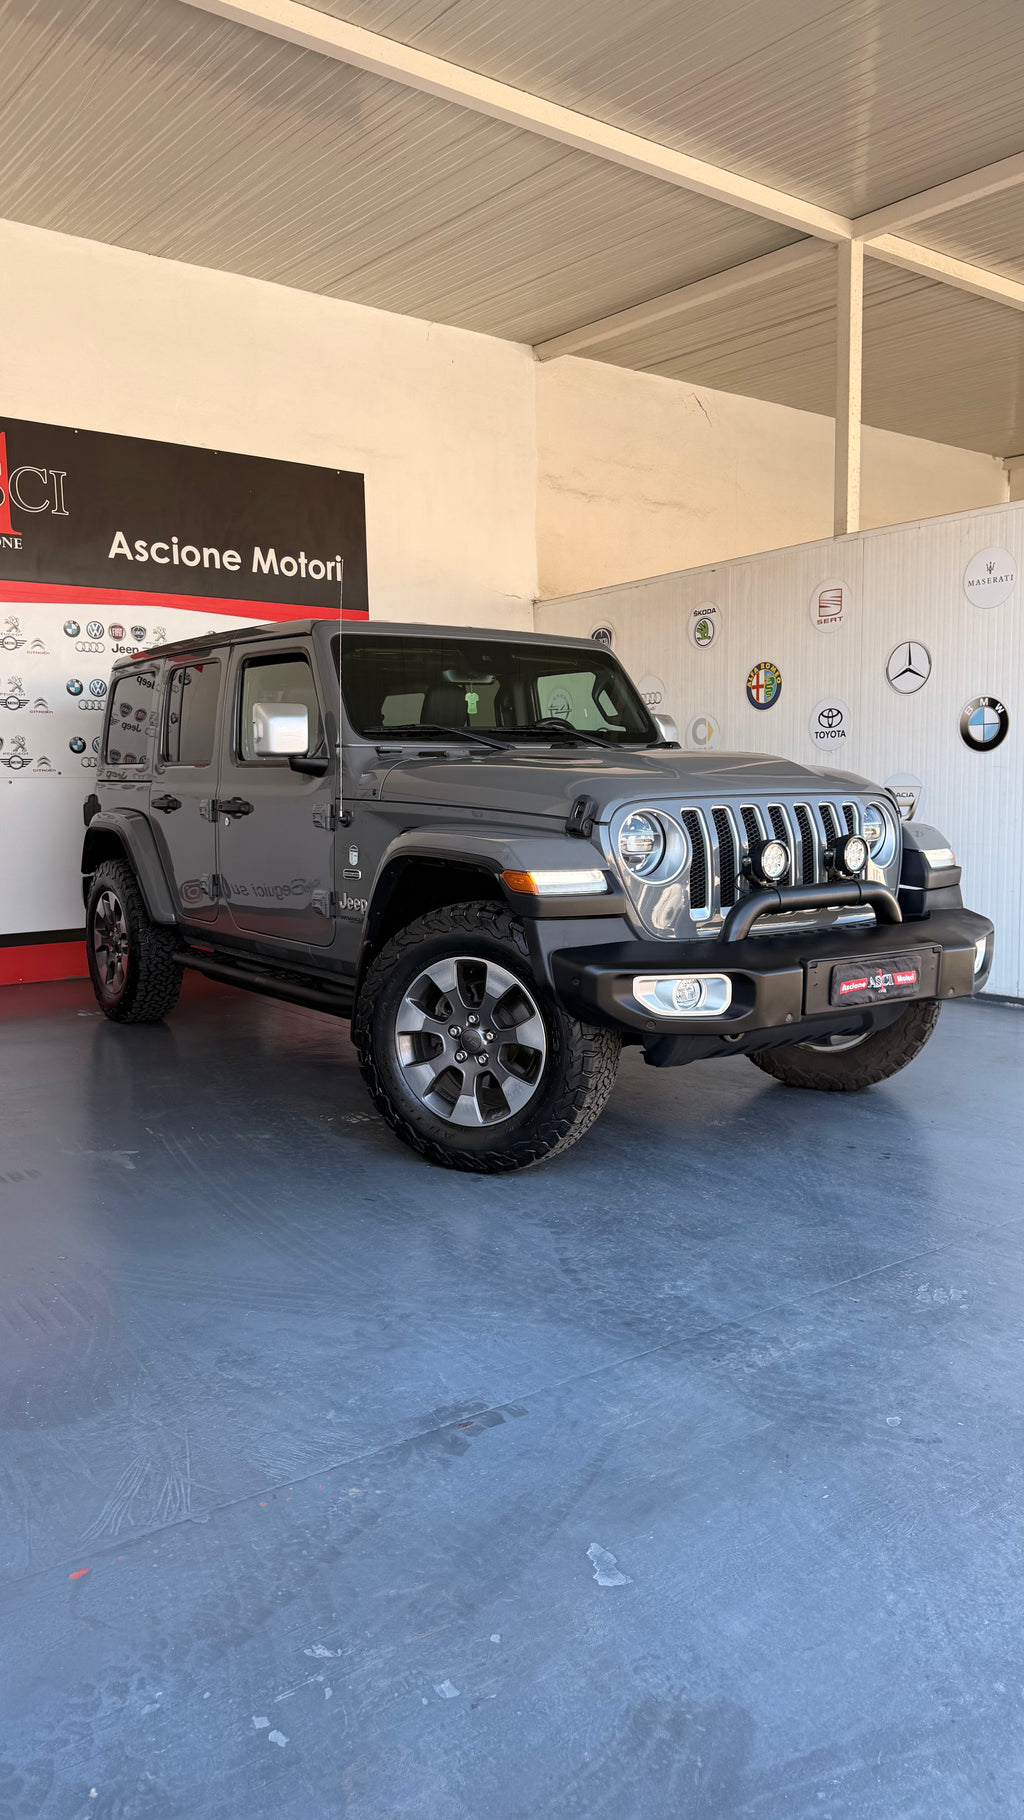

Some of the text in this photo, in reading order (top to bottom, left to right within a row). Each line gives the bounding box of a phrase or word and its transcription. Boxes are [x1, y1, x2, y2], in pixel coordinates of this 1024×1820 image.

[108, 531, 342, 582] Ascione Motori
[967, 574, 1014, 587] MASERATI
[816, 616, 843, 625] SEAT
[760, 662, 782, 684] ROMEO
[964, 697, 1005, 716] BMW
[814, 729, 846, 740] TOYOTA
[339, 892, 368, 915] Jeep
[841, 981, 867, 992] Ascione
